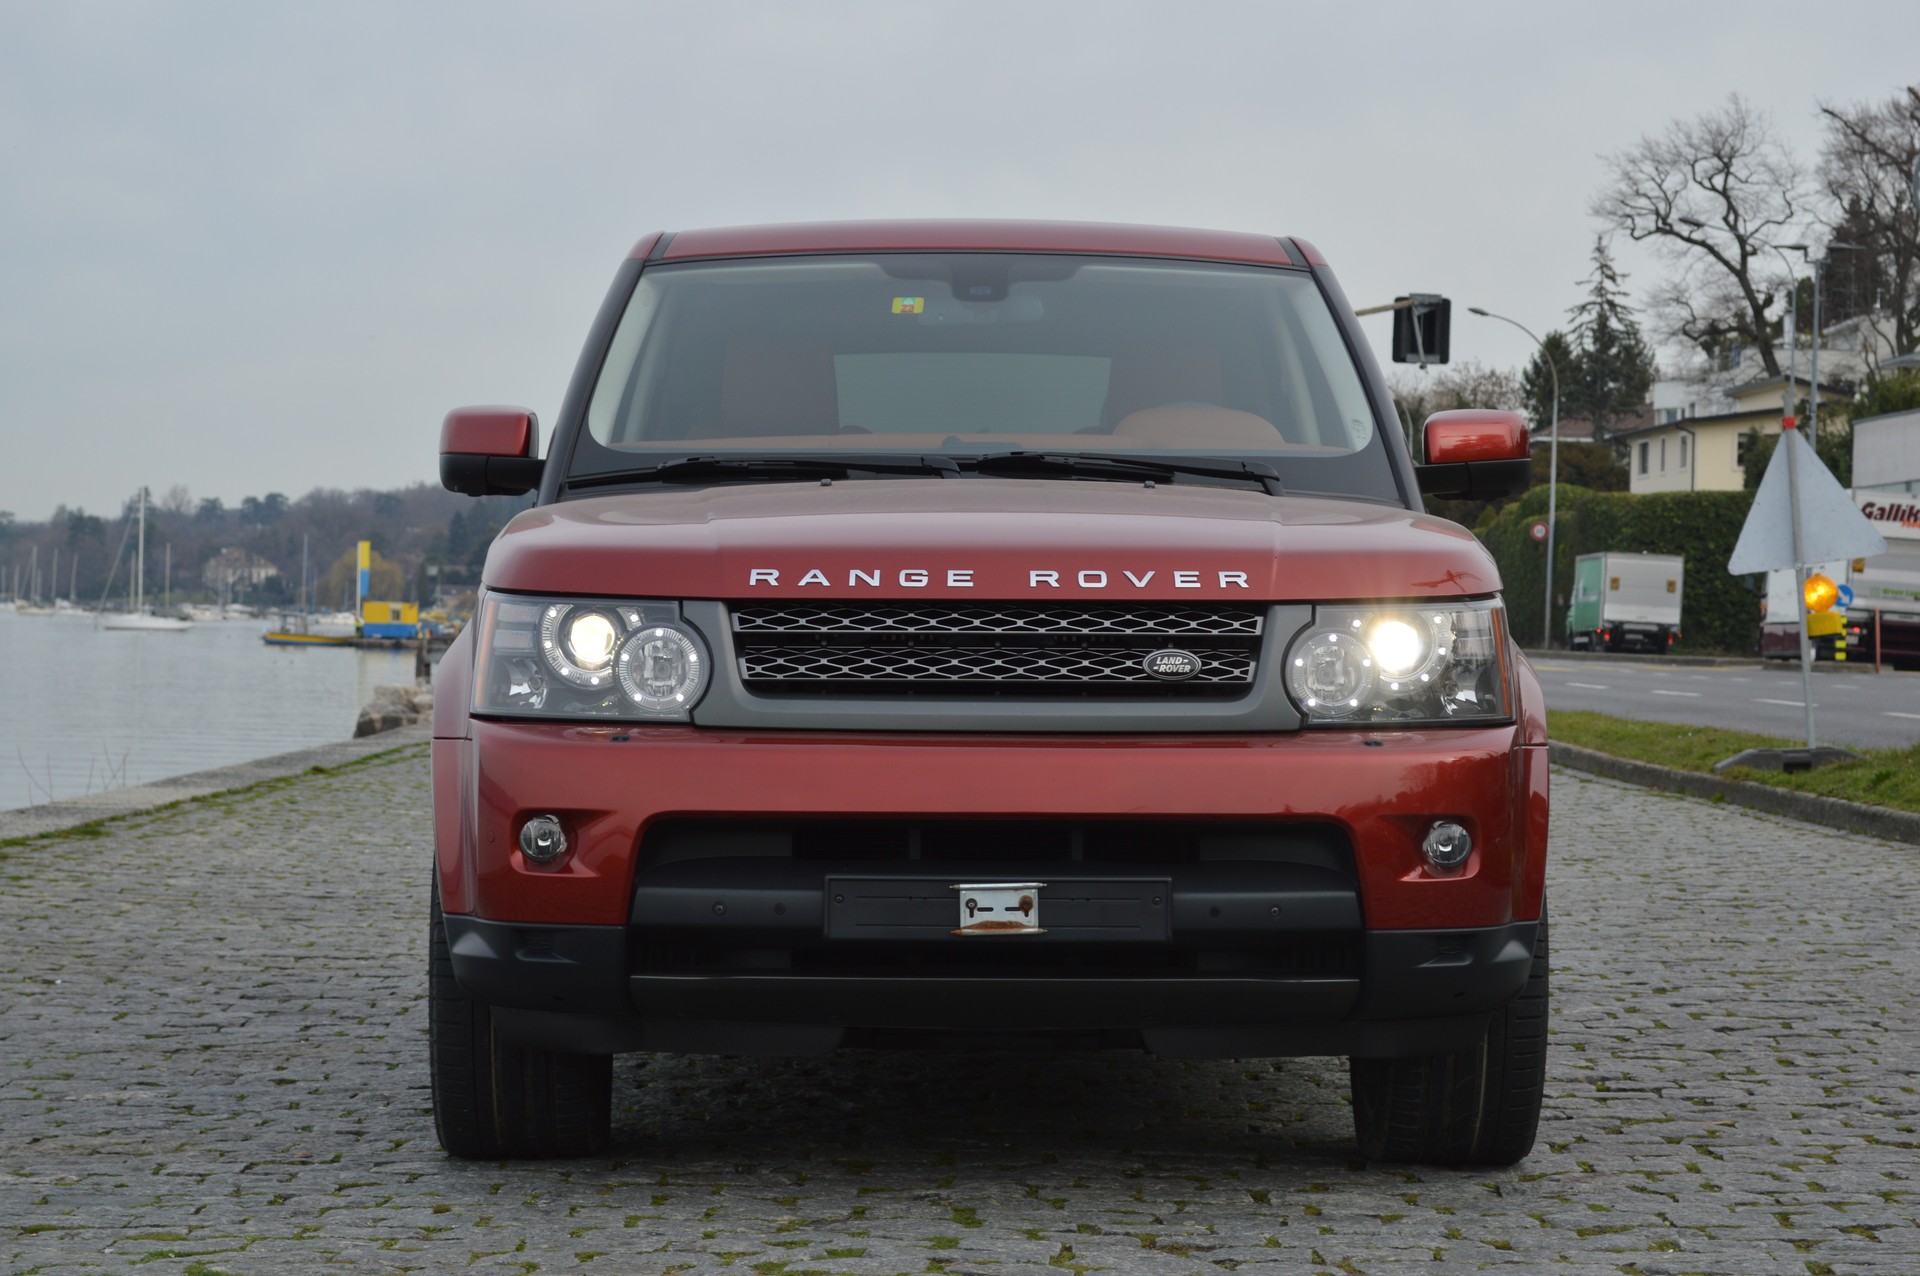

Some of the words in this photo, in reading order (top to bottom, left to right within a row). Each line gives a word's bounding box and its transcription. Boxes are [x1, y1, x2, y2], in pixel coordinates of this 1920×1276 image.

[749, 568, 974, 587] RANGE
[1029, 570, 1250, 588] ROVER
[1156, 656, 1183, 665] LAND
[1158, 664, 1191, 673] ROVER
